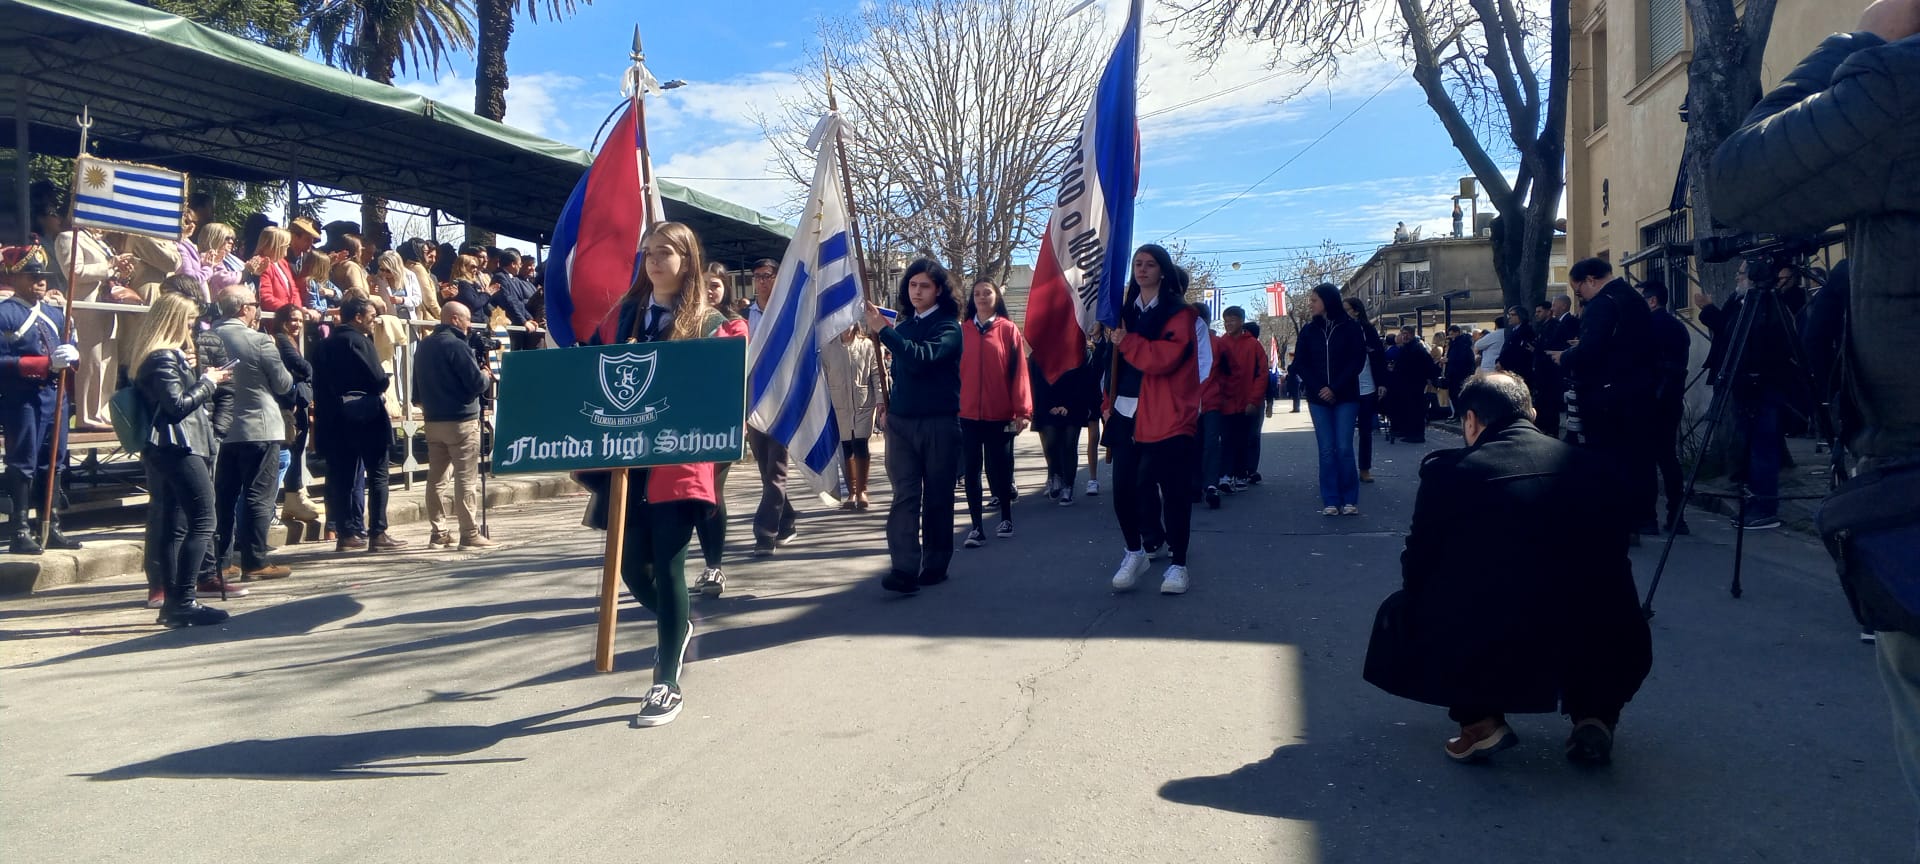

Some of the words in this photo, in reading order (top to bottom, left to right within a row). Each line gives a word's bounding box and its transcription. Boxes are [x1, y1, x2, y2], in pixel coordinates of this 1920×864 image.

[594, 414, 617, 425] FLORIDA
[617, 415, 632, 425] HIGH
[632, 411, 655, 424] SCHOOL
[502, 434, 594, 466] Florida
[602, 431, 648, 460] high
[653, 426, 738, 455] School
